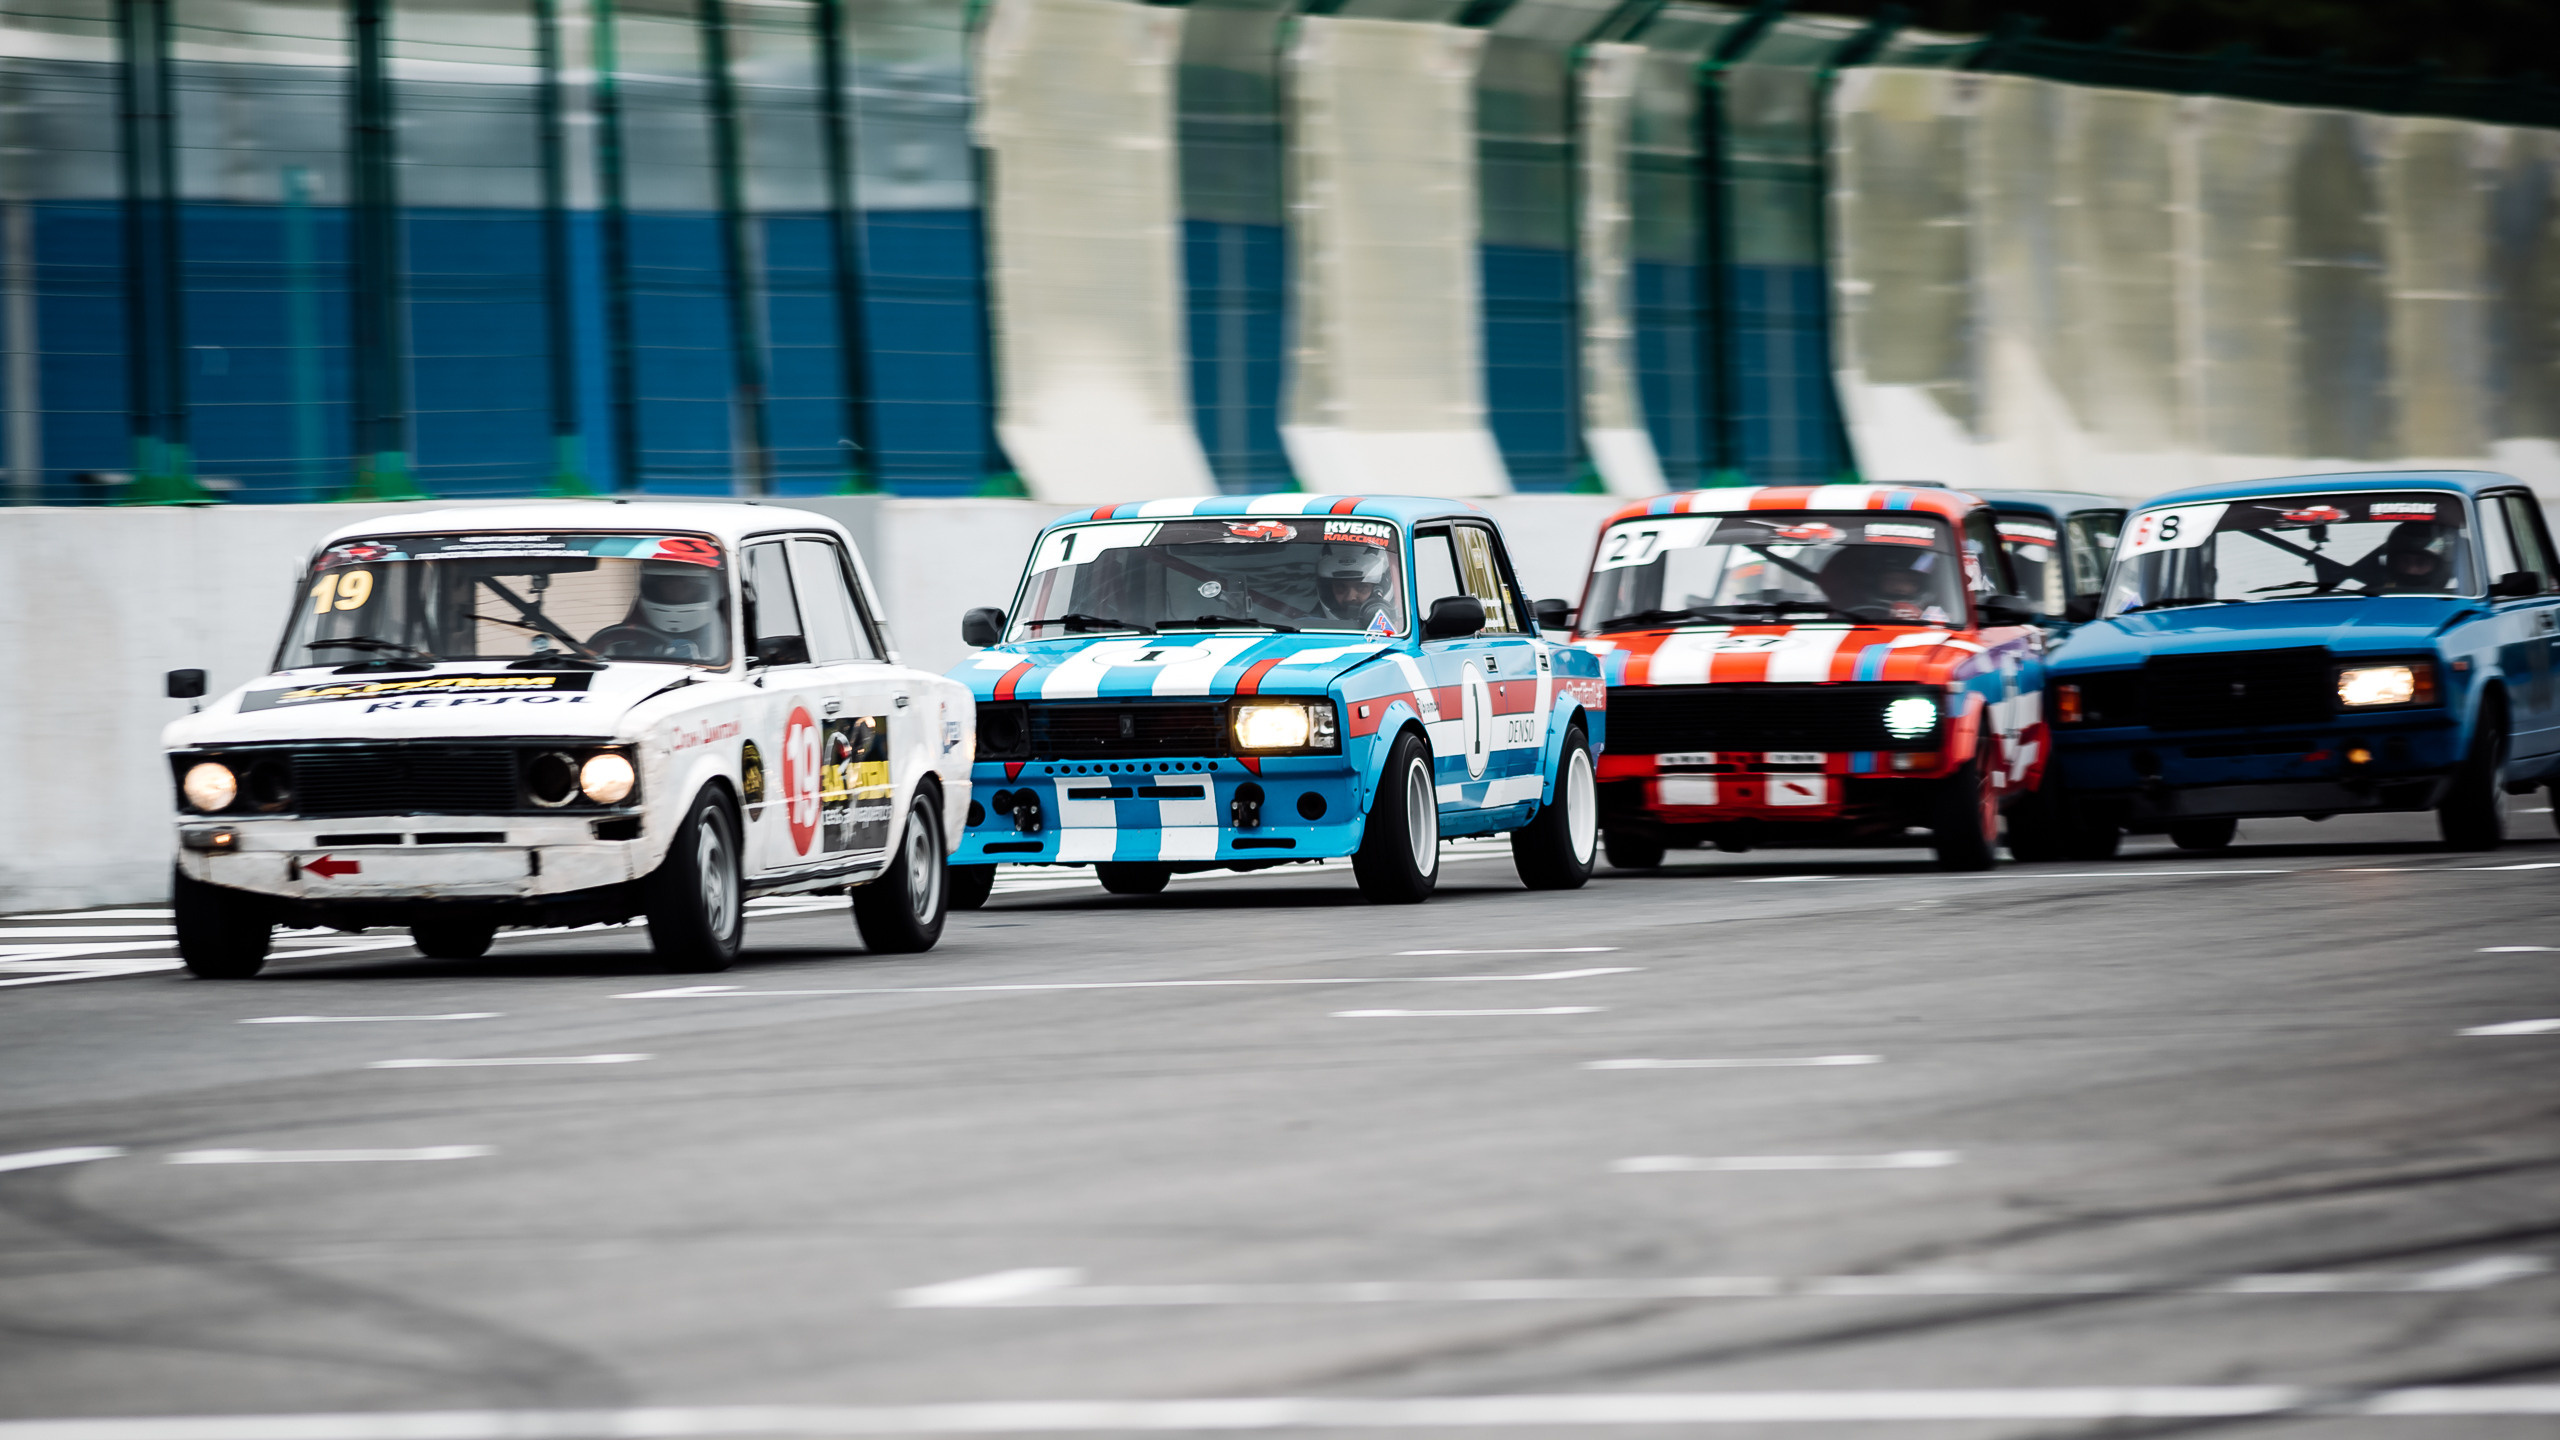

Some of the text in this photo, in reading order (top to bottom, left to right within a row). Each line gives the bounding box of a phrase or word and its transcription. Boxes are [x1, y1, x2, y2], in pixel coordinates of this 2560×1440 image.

[1323, 521, 1392, 538] КУБОК
[1323, 533, 1389, 547] КЛАССИКИ
[1060, 533, 1077, 561] 1
[1609, 530, 1660, 562] 27
[309, 570, 374, 615] 19
[1716, 638, 1786, 649] 27
[1134, 650, 1165, 662] 1
[364, 695, 591, 714] REPSOL
[1472, 683, 1481, 754] 1
[1508, 720, 1535, 743] DENSO
[786, 723, 822, 828] 19
